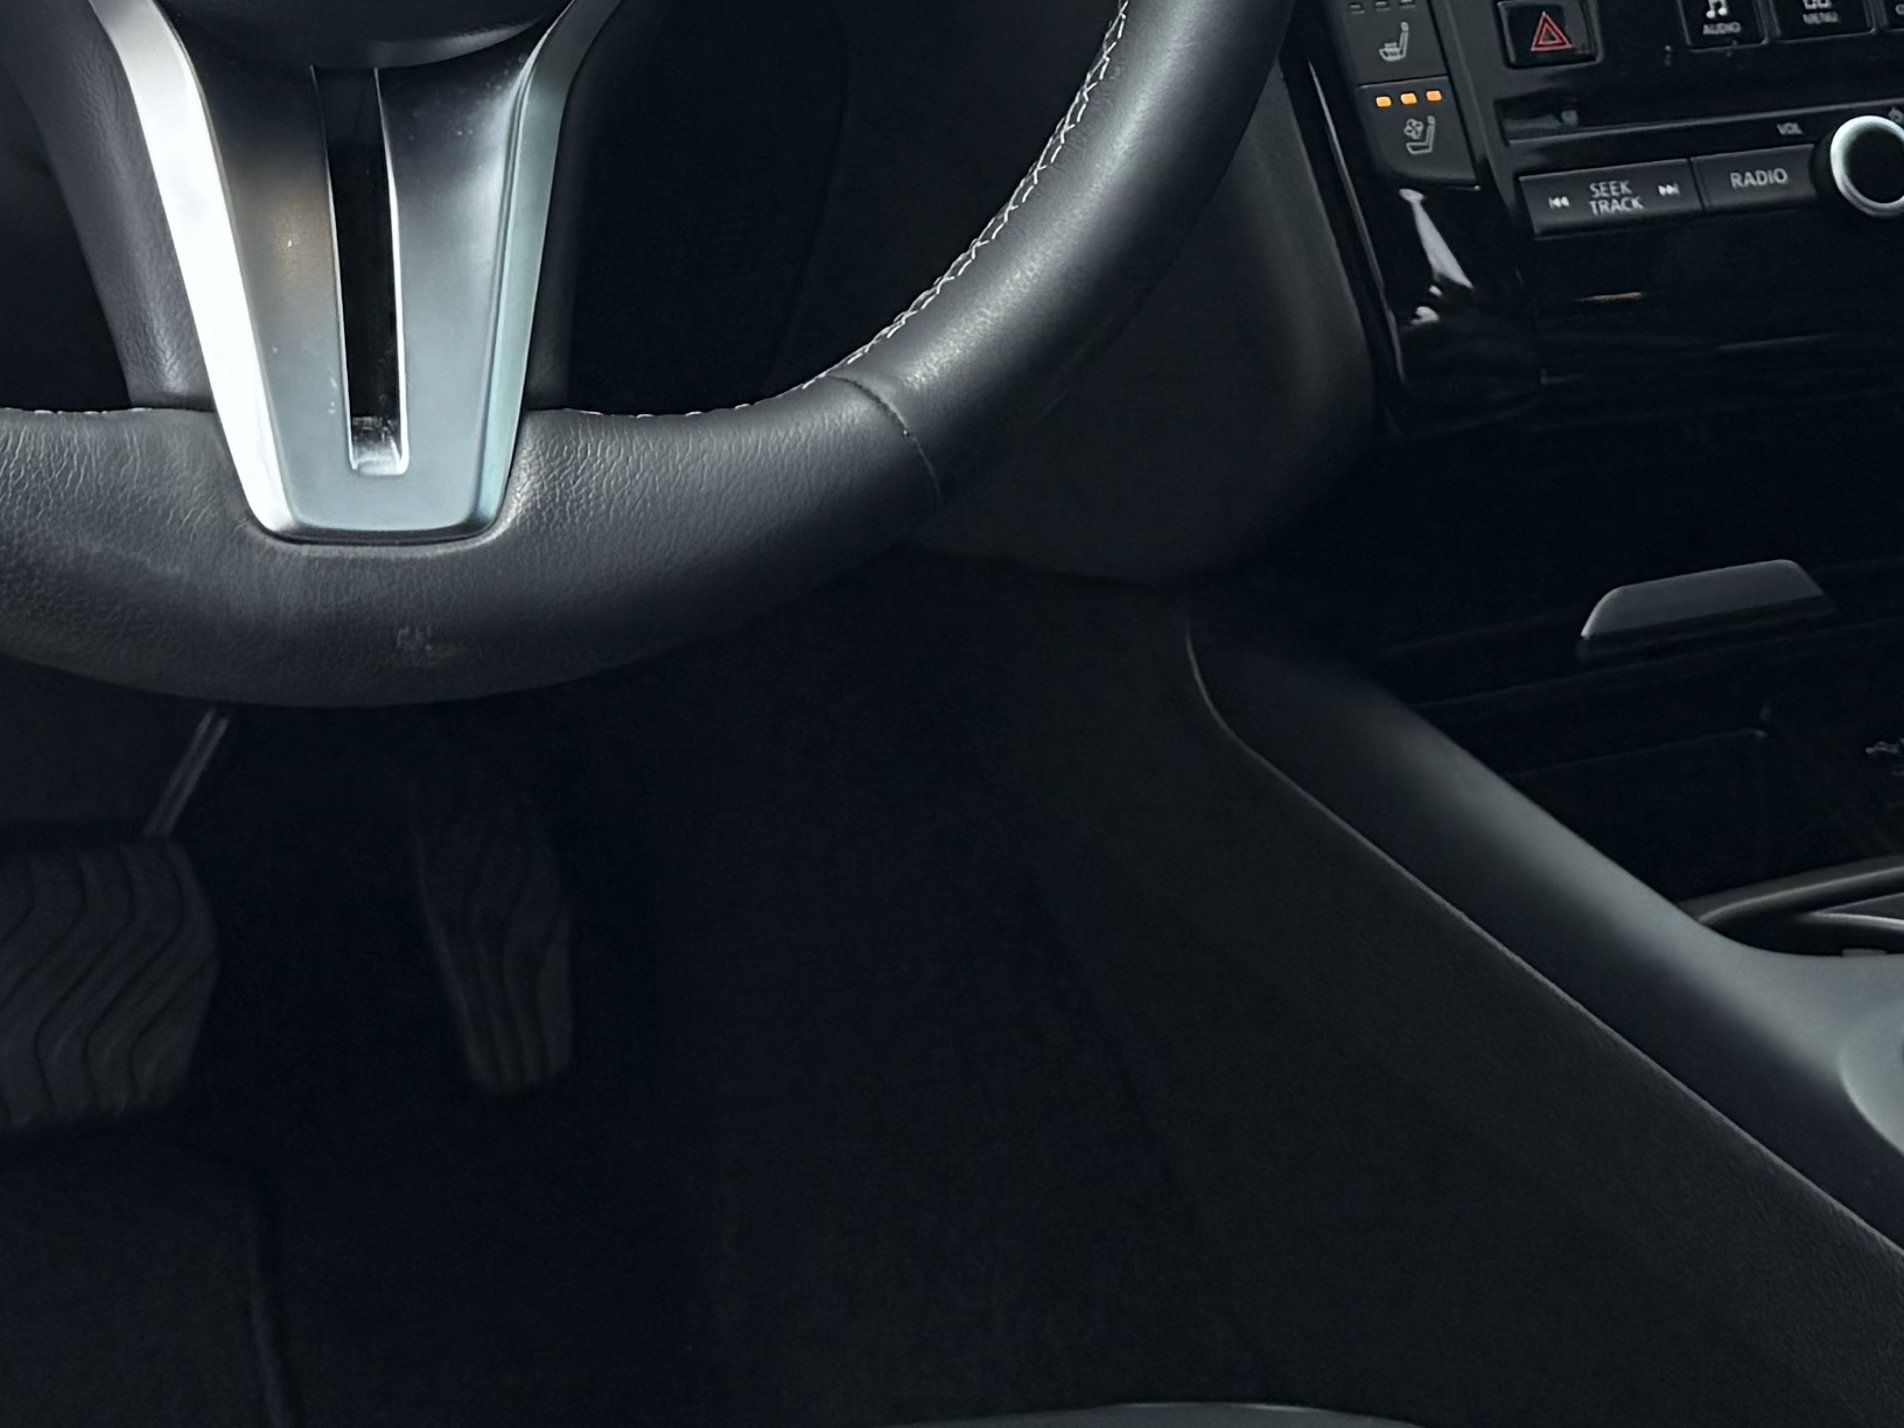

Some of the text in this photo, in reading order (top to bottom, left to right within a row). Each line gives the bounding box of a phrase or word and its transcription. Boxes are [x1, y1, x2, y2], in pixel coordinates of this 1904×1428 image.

[1702, 21, 1742, 36] AUDIO
[1729, 167, 1788, 189] RADIO
[1588, 179, 1633, 198] SEEK
[1587, 195, 1646, 216] TRACK
